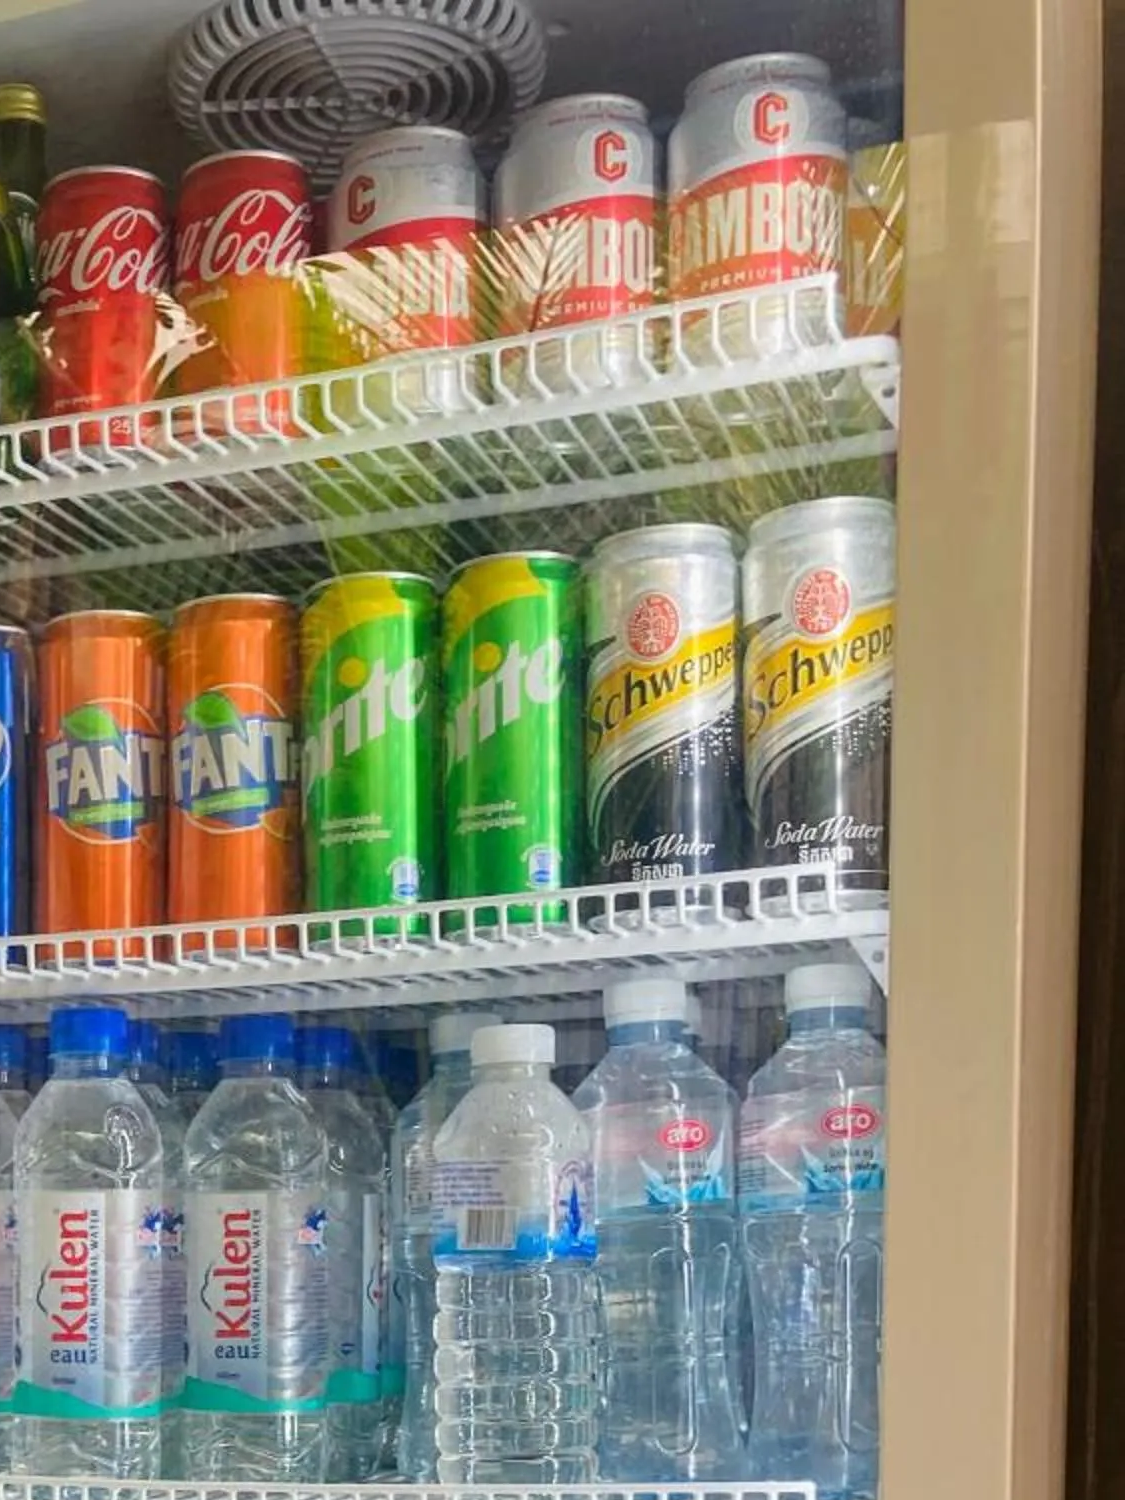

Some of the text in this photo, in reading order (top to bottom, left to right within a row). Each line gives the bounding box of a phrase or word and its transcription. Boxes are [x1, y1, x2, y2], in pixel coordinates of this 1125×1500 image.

[754, 91, 790, 146] C
[594, 130, 629, 183] C
[347, 175, 375, 225] C
[747, 622, 894, 742] Schwepp
[46, 733, 166, 811] FANT
[600, 832, 716, 868] Soda Water
[764, 815, 884, 849] Soda Water
[666, 1125, 705, 1145] aro
[829, 1113, 872, 1132] aro
[49, 1208, 90, 1344] Kulen
[213, 1207, 253, 1341] Kulen
[50, 1348, 87, 1365] eau
[214, 1343, 251, 1360] eau
